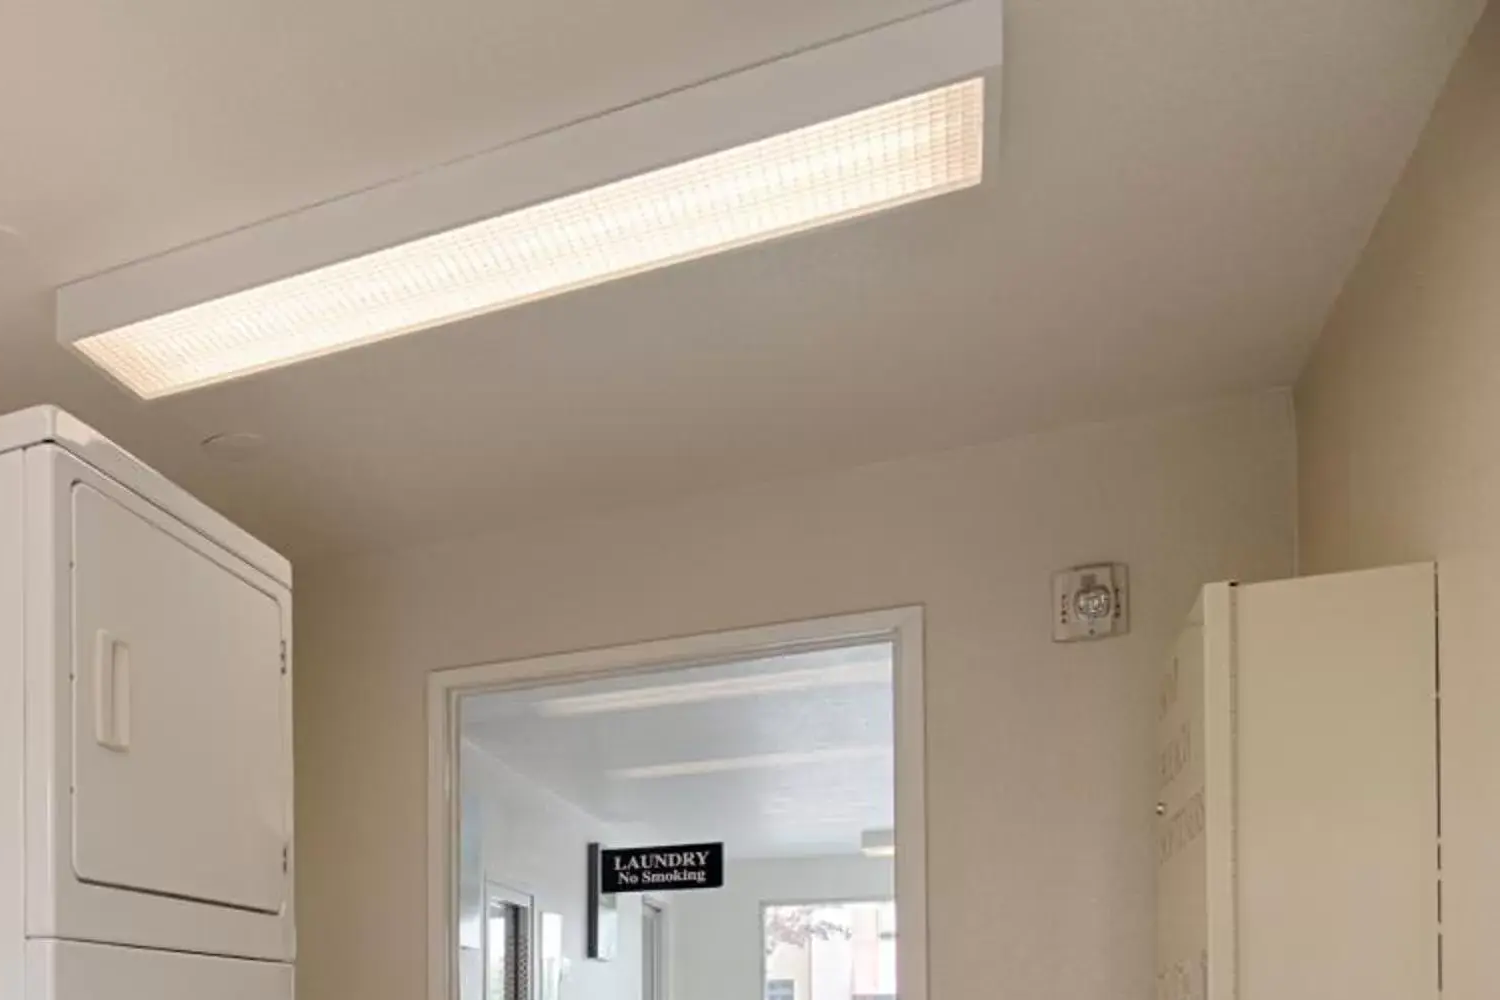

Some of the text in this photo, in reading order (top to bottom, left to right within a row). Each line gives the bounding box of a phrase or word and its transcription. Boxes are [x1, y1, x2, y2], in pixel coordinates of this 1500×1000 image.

[614, 851, 710, 871] LAUNDRY
[617, 868, 707, 885] No Smoking
